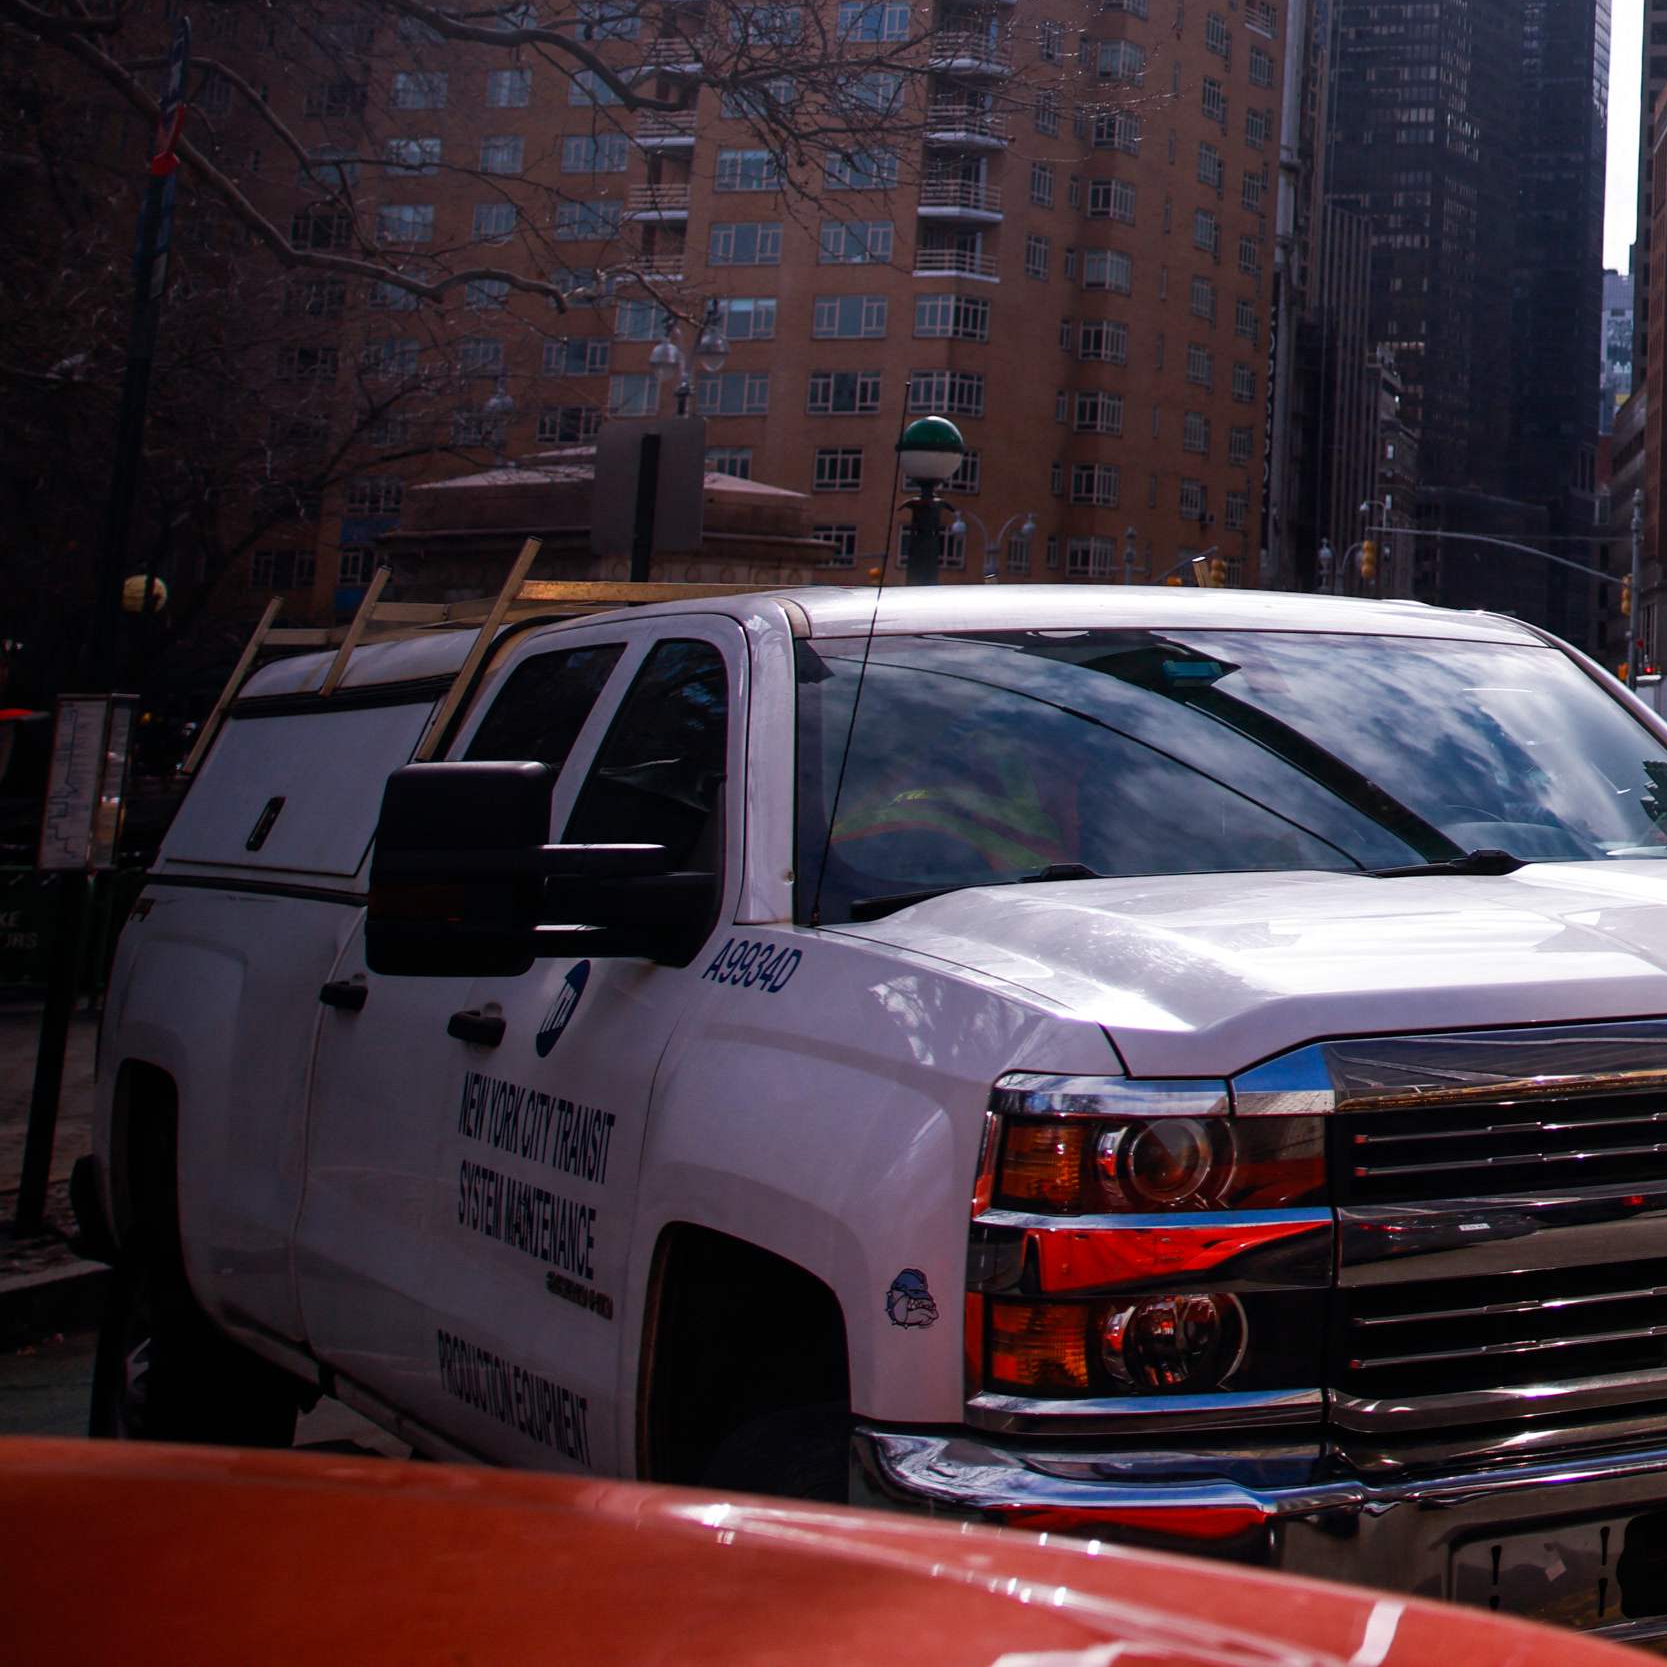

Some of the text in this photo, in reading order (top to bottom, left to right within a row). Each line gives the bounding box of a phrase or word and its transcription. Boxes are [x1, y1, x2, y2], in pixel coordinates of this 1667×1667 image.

[702, 937, 803, 994] A9934D
[458, 1071, 616, 1185] NEW YORK CITY TRANSIT
[457, 1159, 597, 1280] SYSTEM MAINTENANCE
